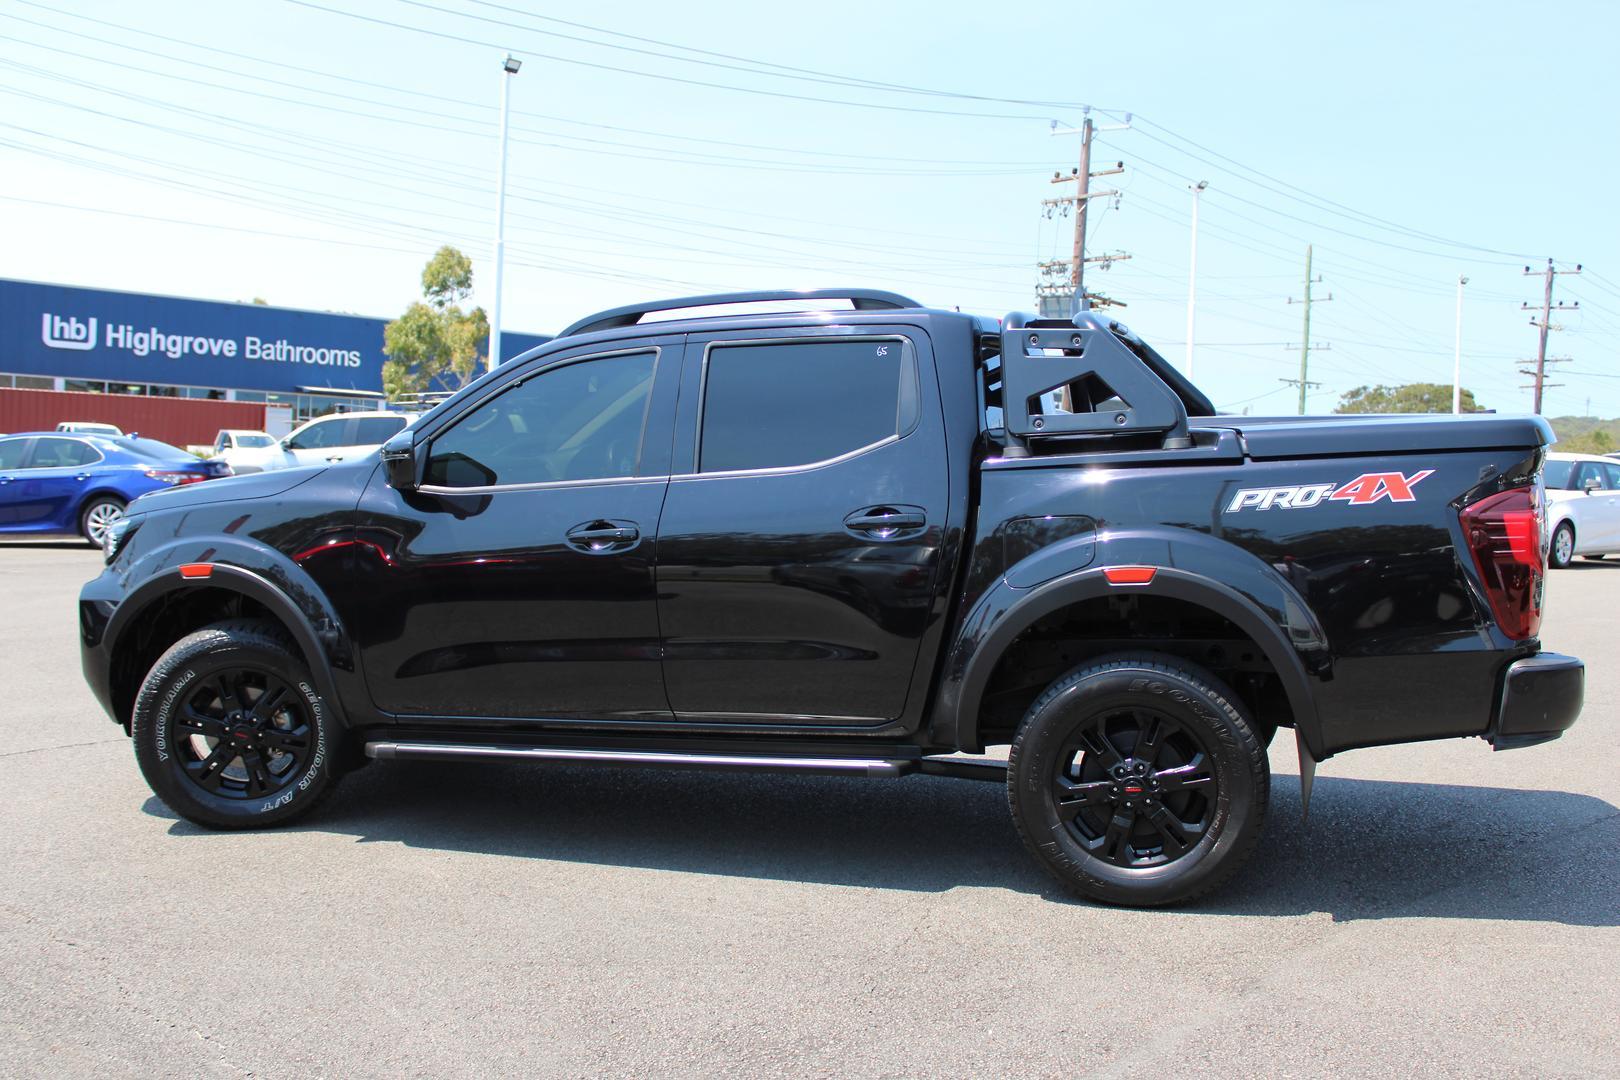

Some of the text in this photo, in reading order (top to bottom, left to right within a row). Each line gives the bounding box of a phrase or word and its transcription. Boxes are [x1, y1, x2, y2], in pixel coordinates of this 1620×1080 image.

[105, 323, 361, 368] Highgrove Bathrooms
[876, 345, 888, 357] 65
[155, 670, 196, 761] YOKOHAMA
[299, 682, 326, 790] GEOLANDAR
[261, 791, 293, 812] A/T
